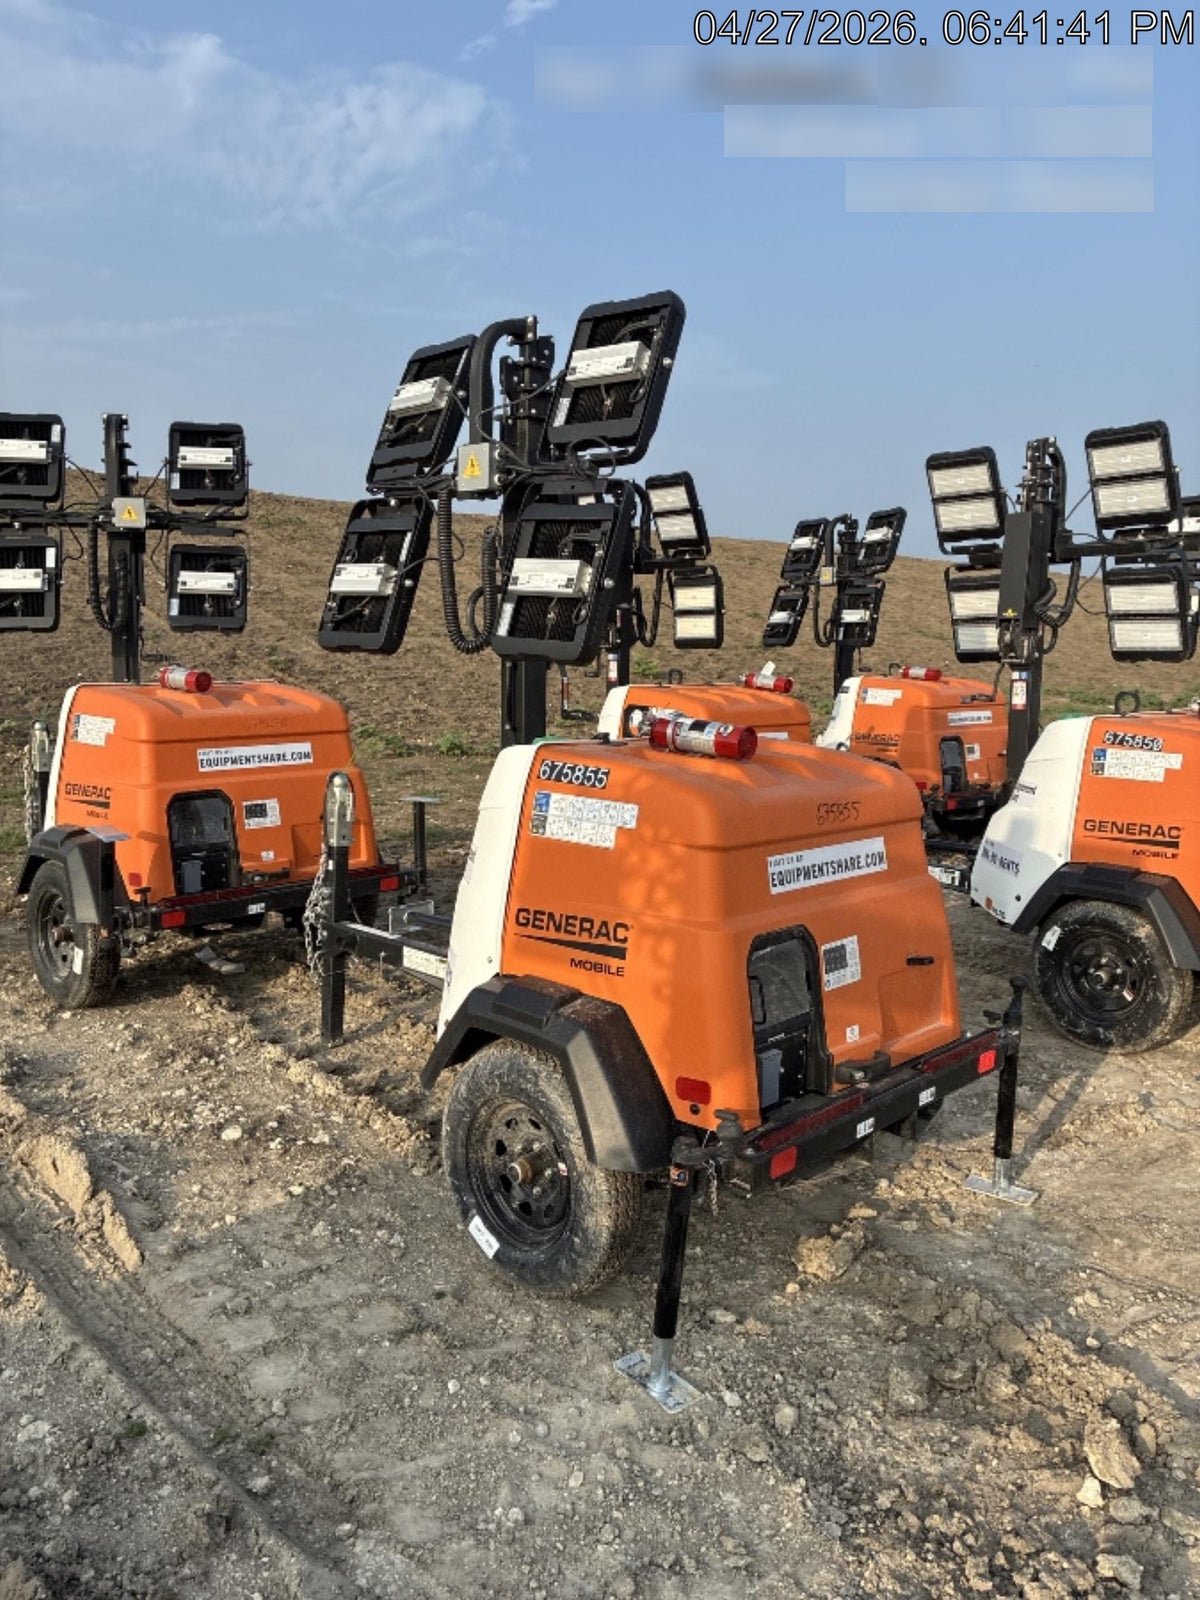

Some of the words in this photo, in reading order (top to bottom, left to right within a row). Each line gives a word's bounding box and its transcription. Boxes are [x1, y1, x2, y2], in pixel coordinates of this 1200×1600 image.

[200, 751, 312, 769] EQUIPMENTSHARE.COM
[539, 760, 609, 788] 675855
[1083, 818, 1181, 840] GENERAC
[770, 851, 886, 888] EQUIPMENTSHARE.COM
[514, 907, 631, 945] GENERAC
[569, 957, 625, 978] MOBILE
